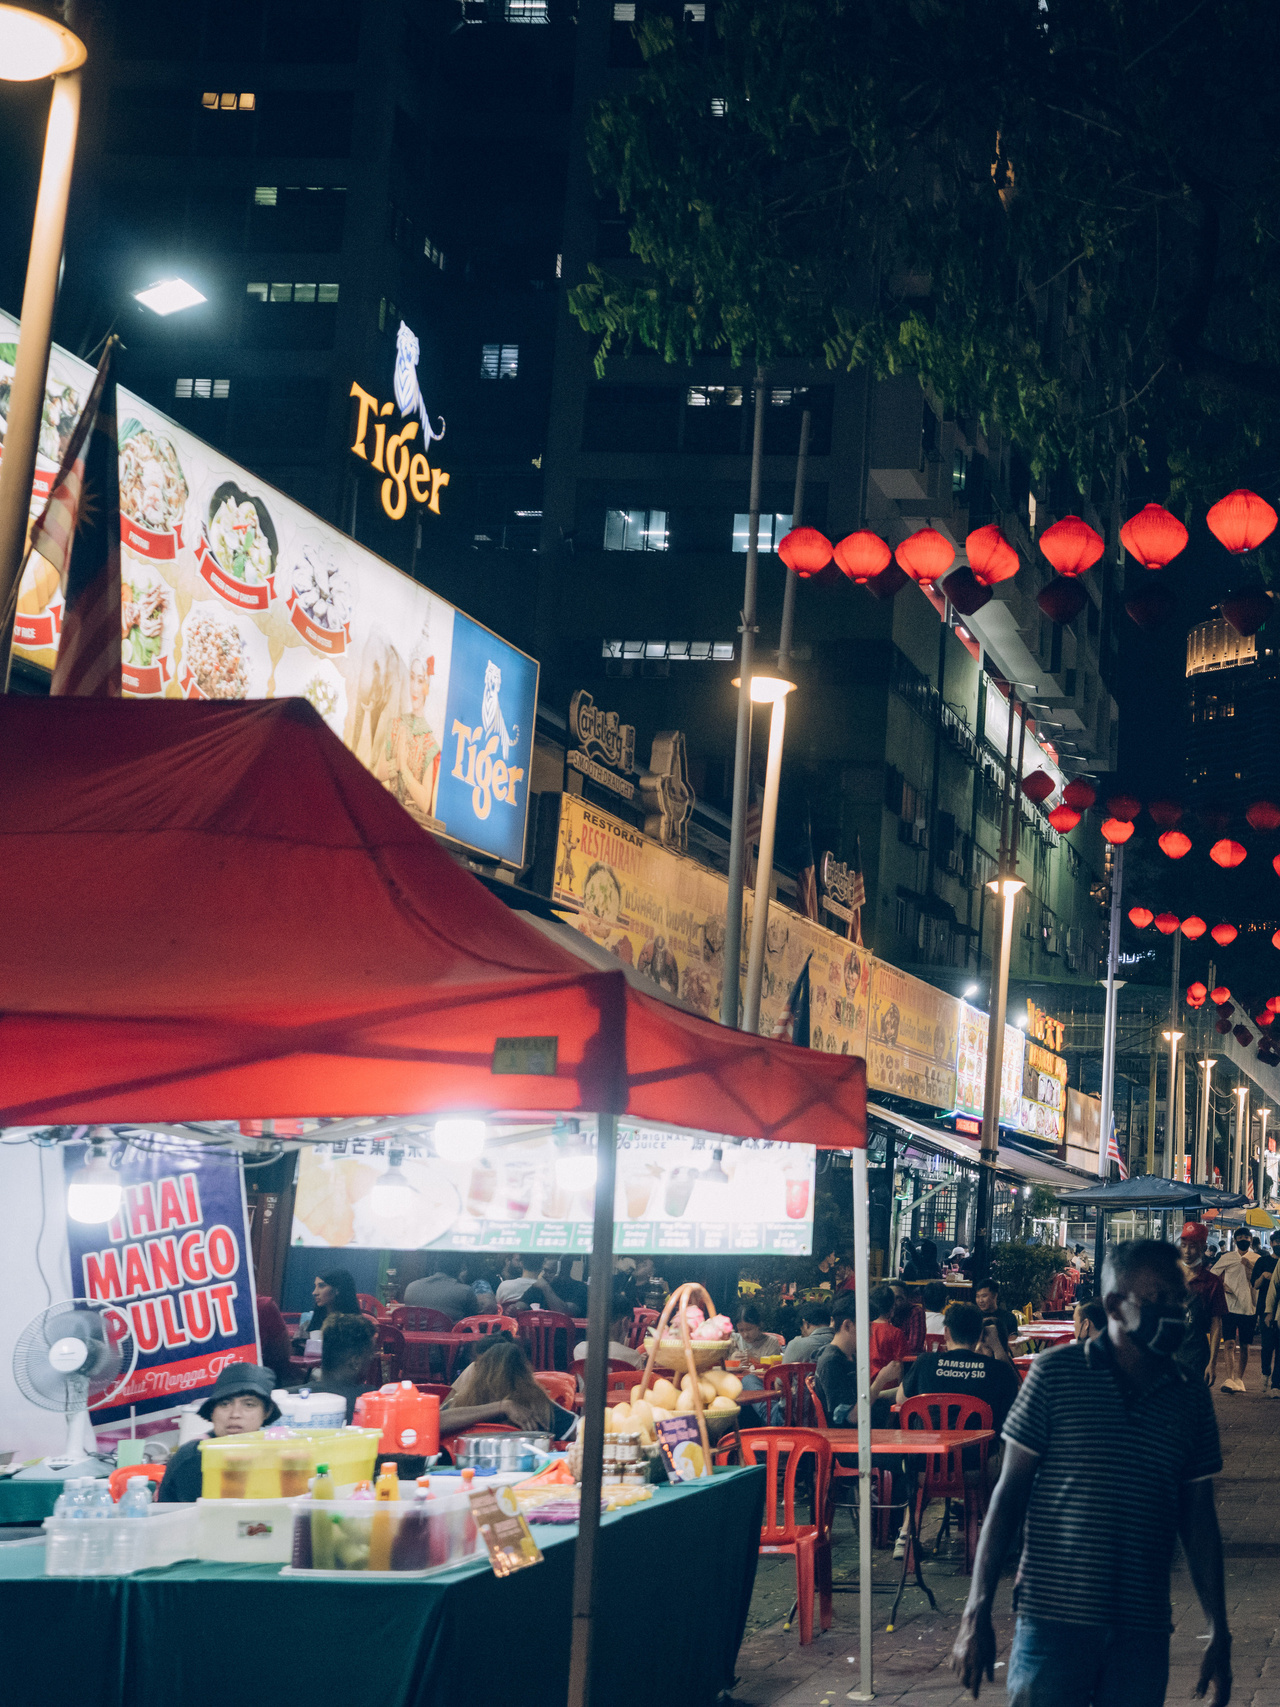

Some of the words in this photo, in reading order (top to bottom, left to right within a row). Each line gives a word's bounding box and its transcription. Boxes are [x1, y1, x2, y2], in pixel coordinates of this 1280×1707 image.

[349, 381, 450, 520] Tiger
[570, 689, 623, 766] Carlsberg
[451, 718, 524, 820] Tiger
[573, 752, 602, 782] SMOOTH
[602, 768, 634, 800] DRAUGHT
[580, 823, 643, 878] RESTAURANT
[583, 810, 643, 848] RESTORAN
[634, 1141, 667, 1150] JUICE
[82, 1223, 240, 1306] MANGO
[99, 1281, 239, 1355] PULUT
[145, 1368, 208, 1391] Mangga
[935, 1368, 970, 1379] Galaxy
[971, 1370, 986, 1378] S10
[937, 1358, 985, 1369] SAMSUNG
